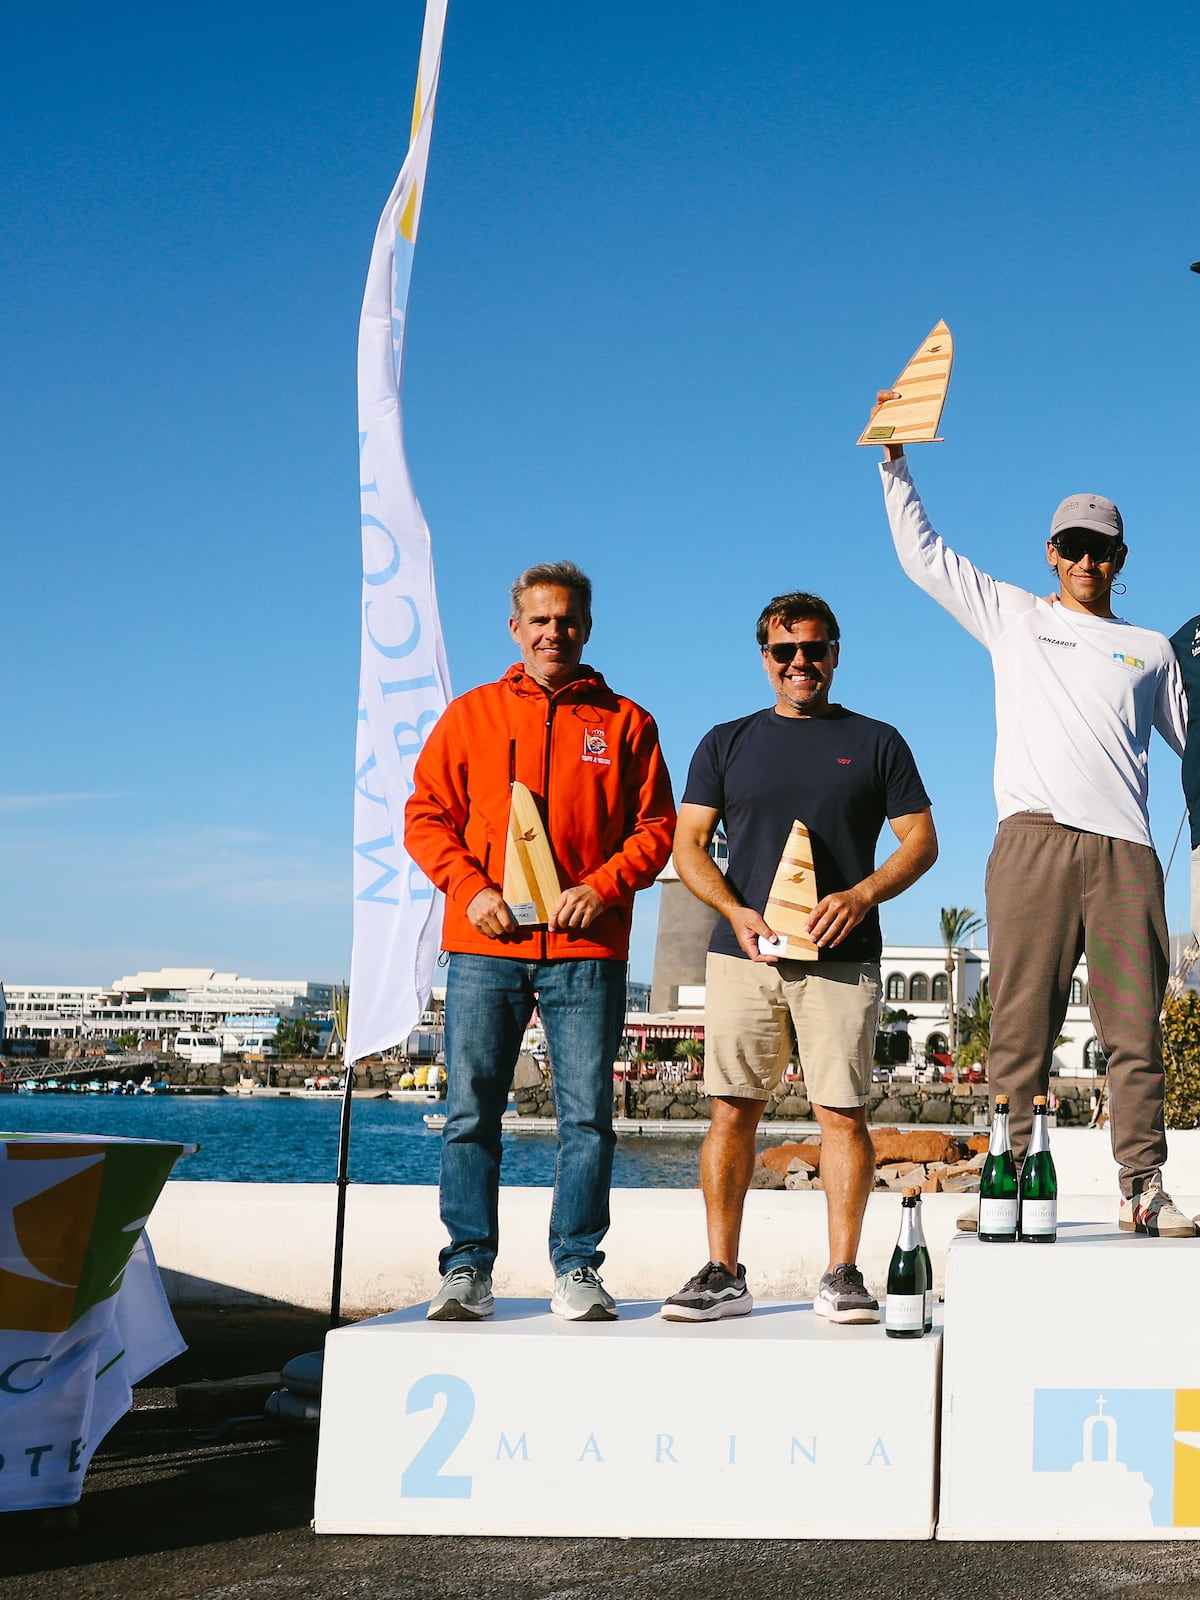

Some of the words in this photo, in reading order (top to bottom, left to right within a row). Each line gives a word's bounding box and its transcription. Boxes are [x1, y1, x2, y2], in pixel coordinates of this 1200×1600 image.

[1037, 634, 1078, 649] LANZAROTE
[400, 1373, 476, 1499] 2
[495, 1431, 894, 1466] MARINA
